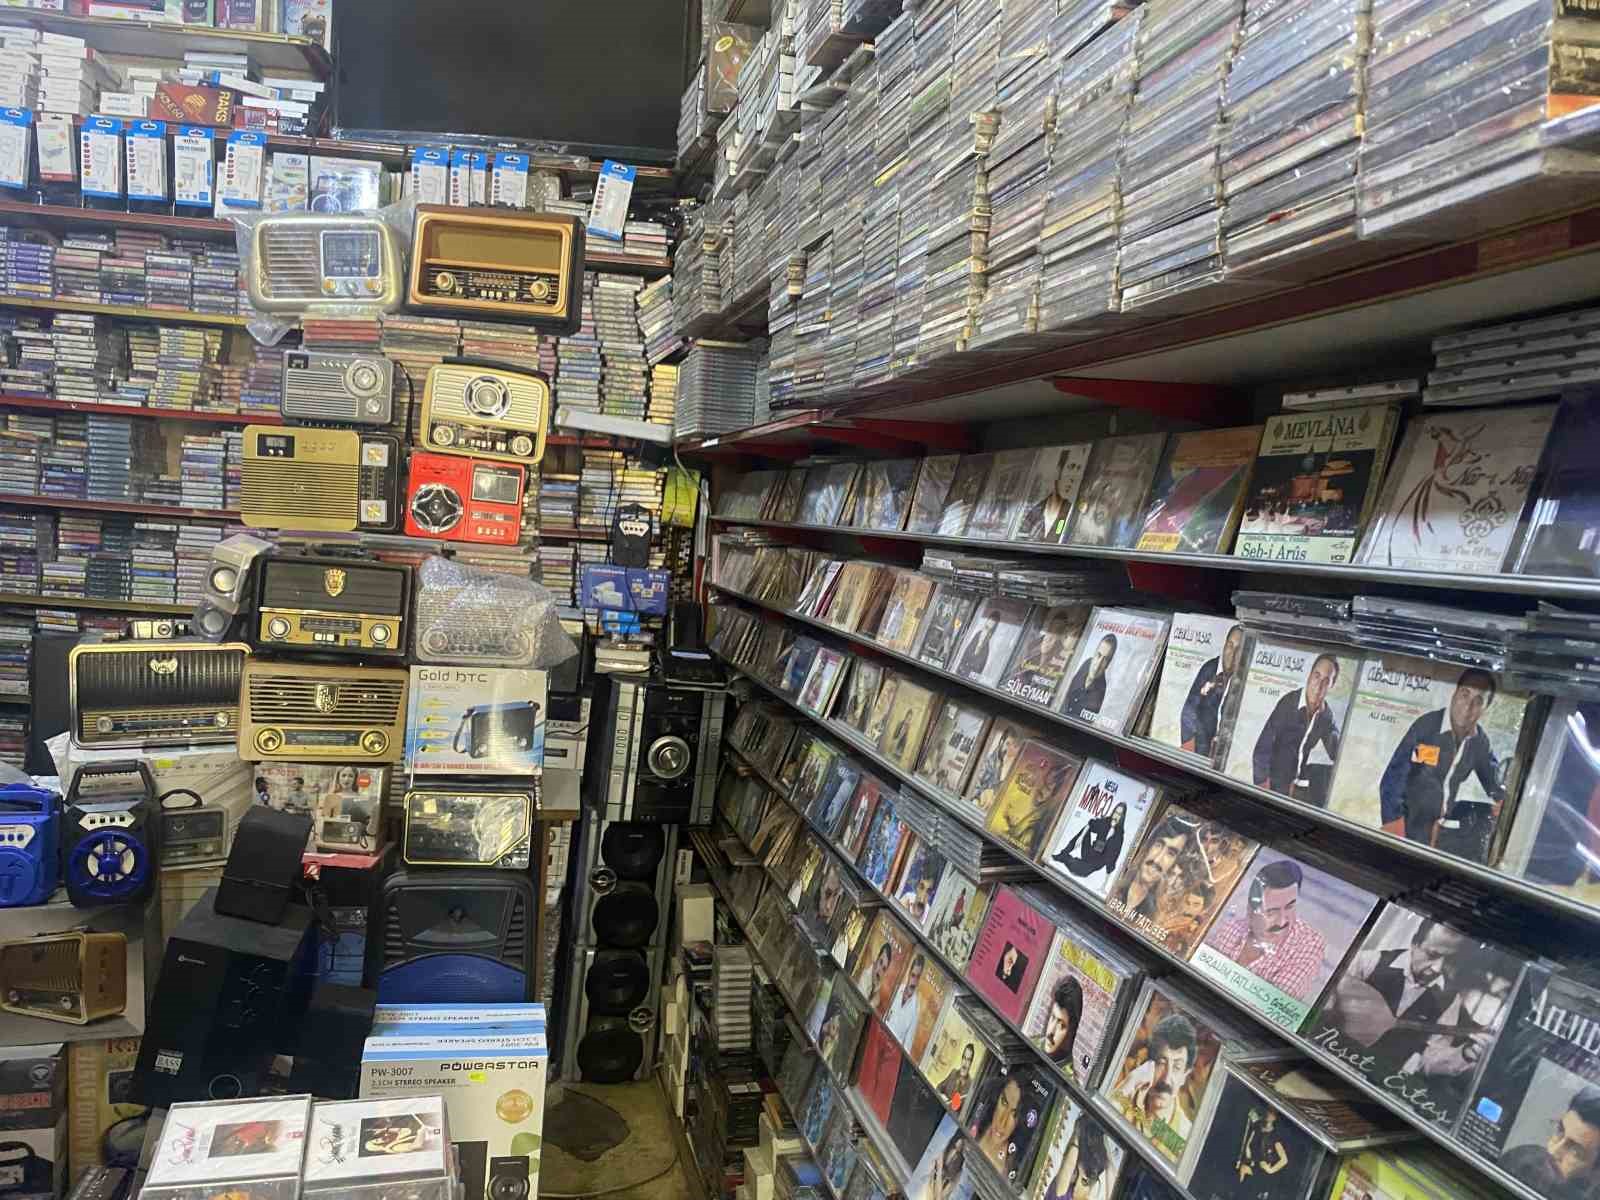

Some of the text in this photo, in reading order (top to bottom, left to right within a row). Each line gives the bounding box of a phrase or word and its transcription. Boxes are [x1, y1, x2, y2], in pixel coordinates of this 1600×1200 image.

[214, 90, 230, 123] RAKS
[418, 669, 449, 681] Gold
[371, 1067, 414, 1077] PW-3007
[394, 1078, 422, 1086] STEREO
